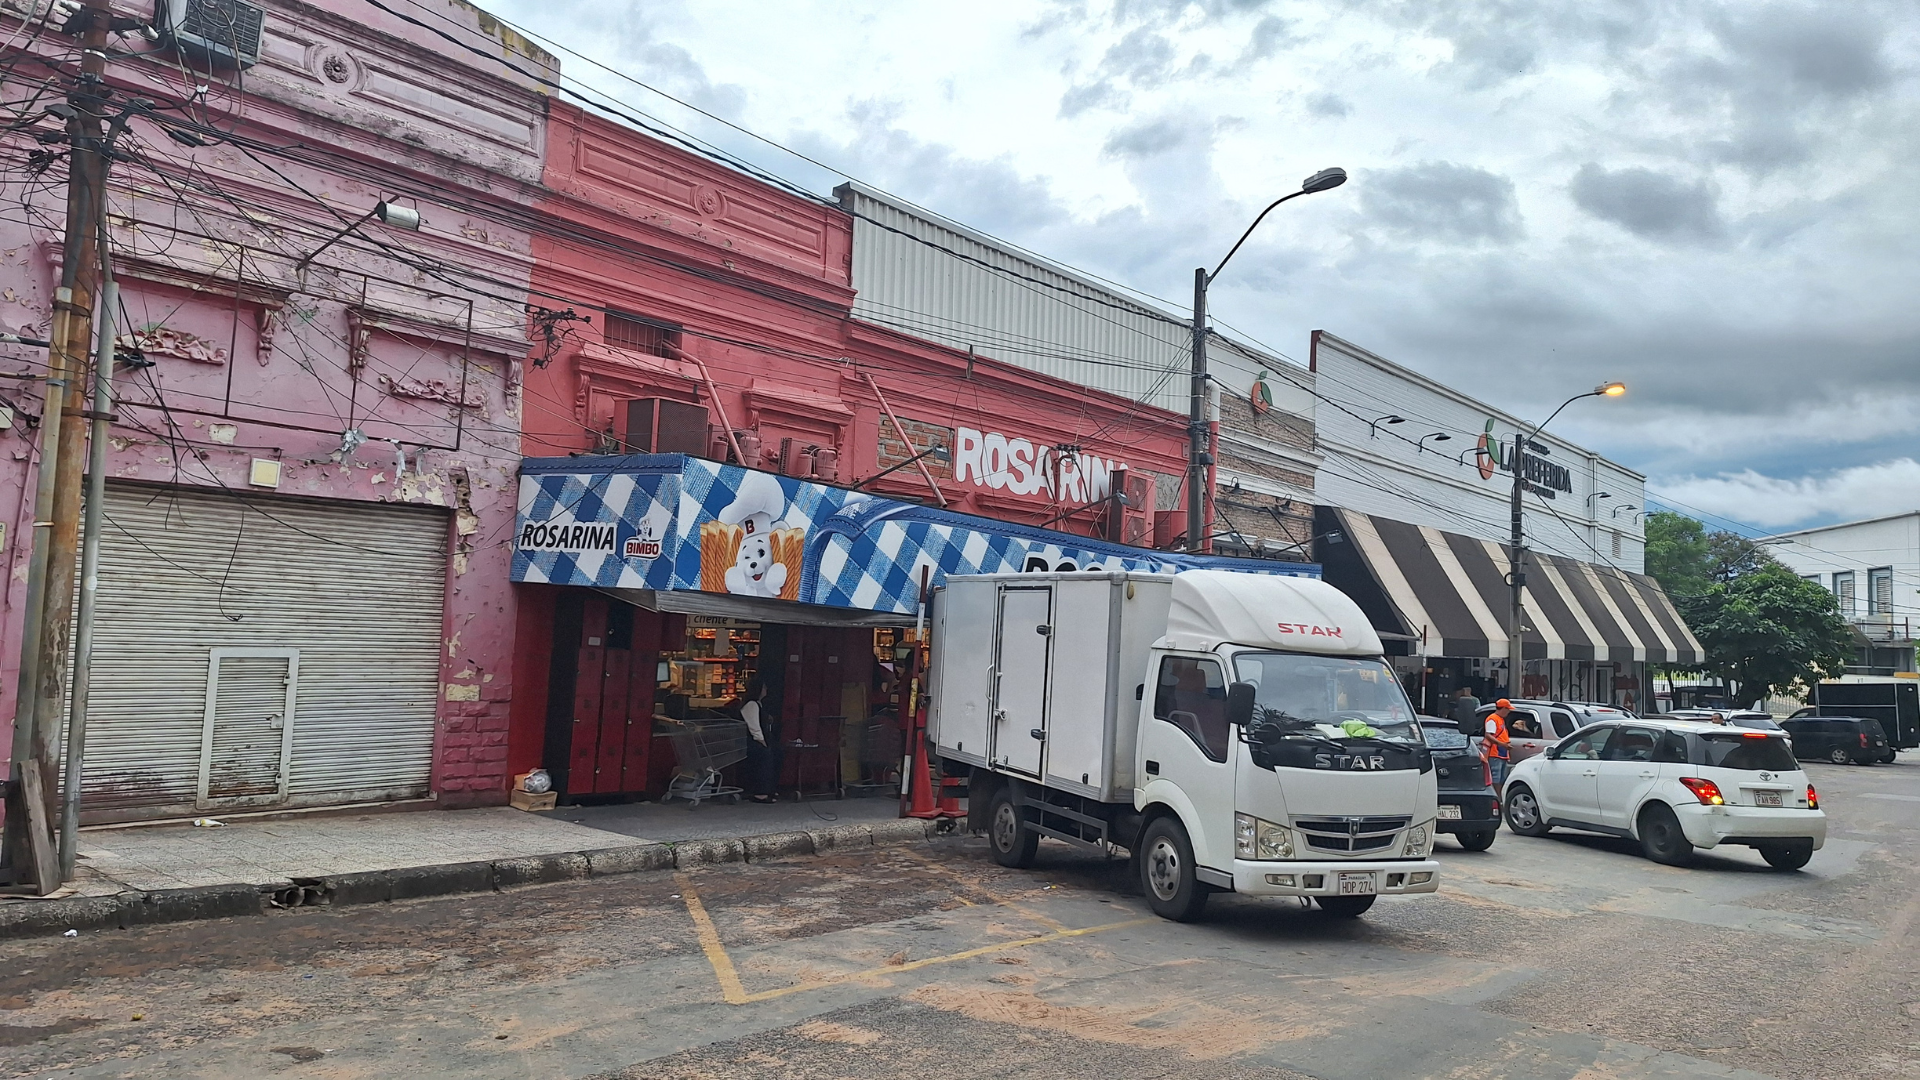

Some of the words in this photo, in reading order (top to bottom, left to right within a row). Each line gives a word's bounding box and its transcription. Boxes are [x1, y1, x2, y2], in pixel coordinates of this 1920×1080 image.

[955, 426, 1129, 504] ROSARIN
[745, 519, 755, 534] B
[520, 523, 615, 551] ROSARINA
[626, 542, 659, 556] BIMBO
[1277, 622, 1343, 639] STAR
[1315, 753, 1385, 770] STAR
[1342, 881, 1357, 894] HDP
[1358, 881, 1373, 894] 274
